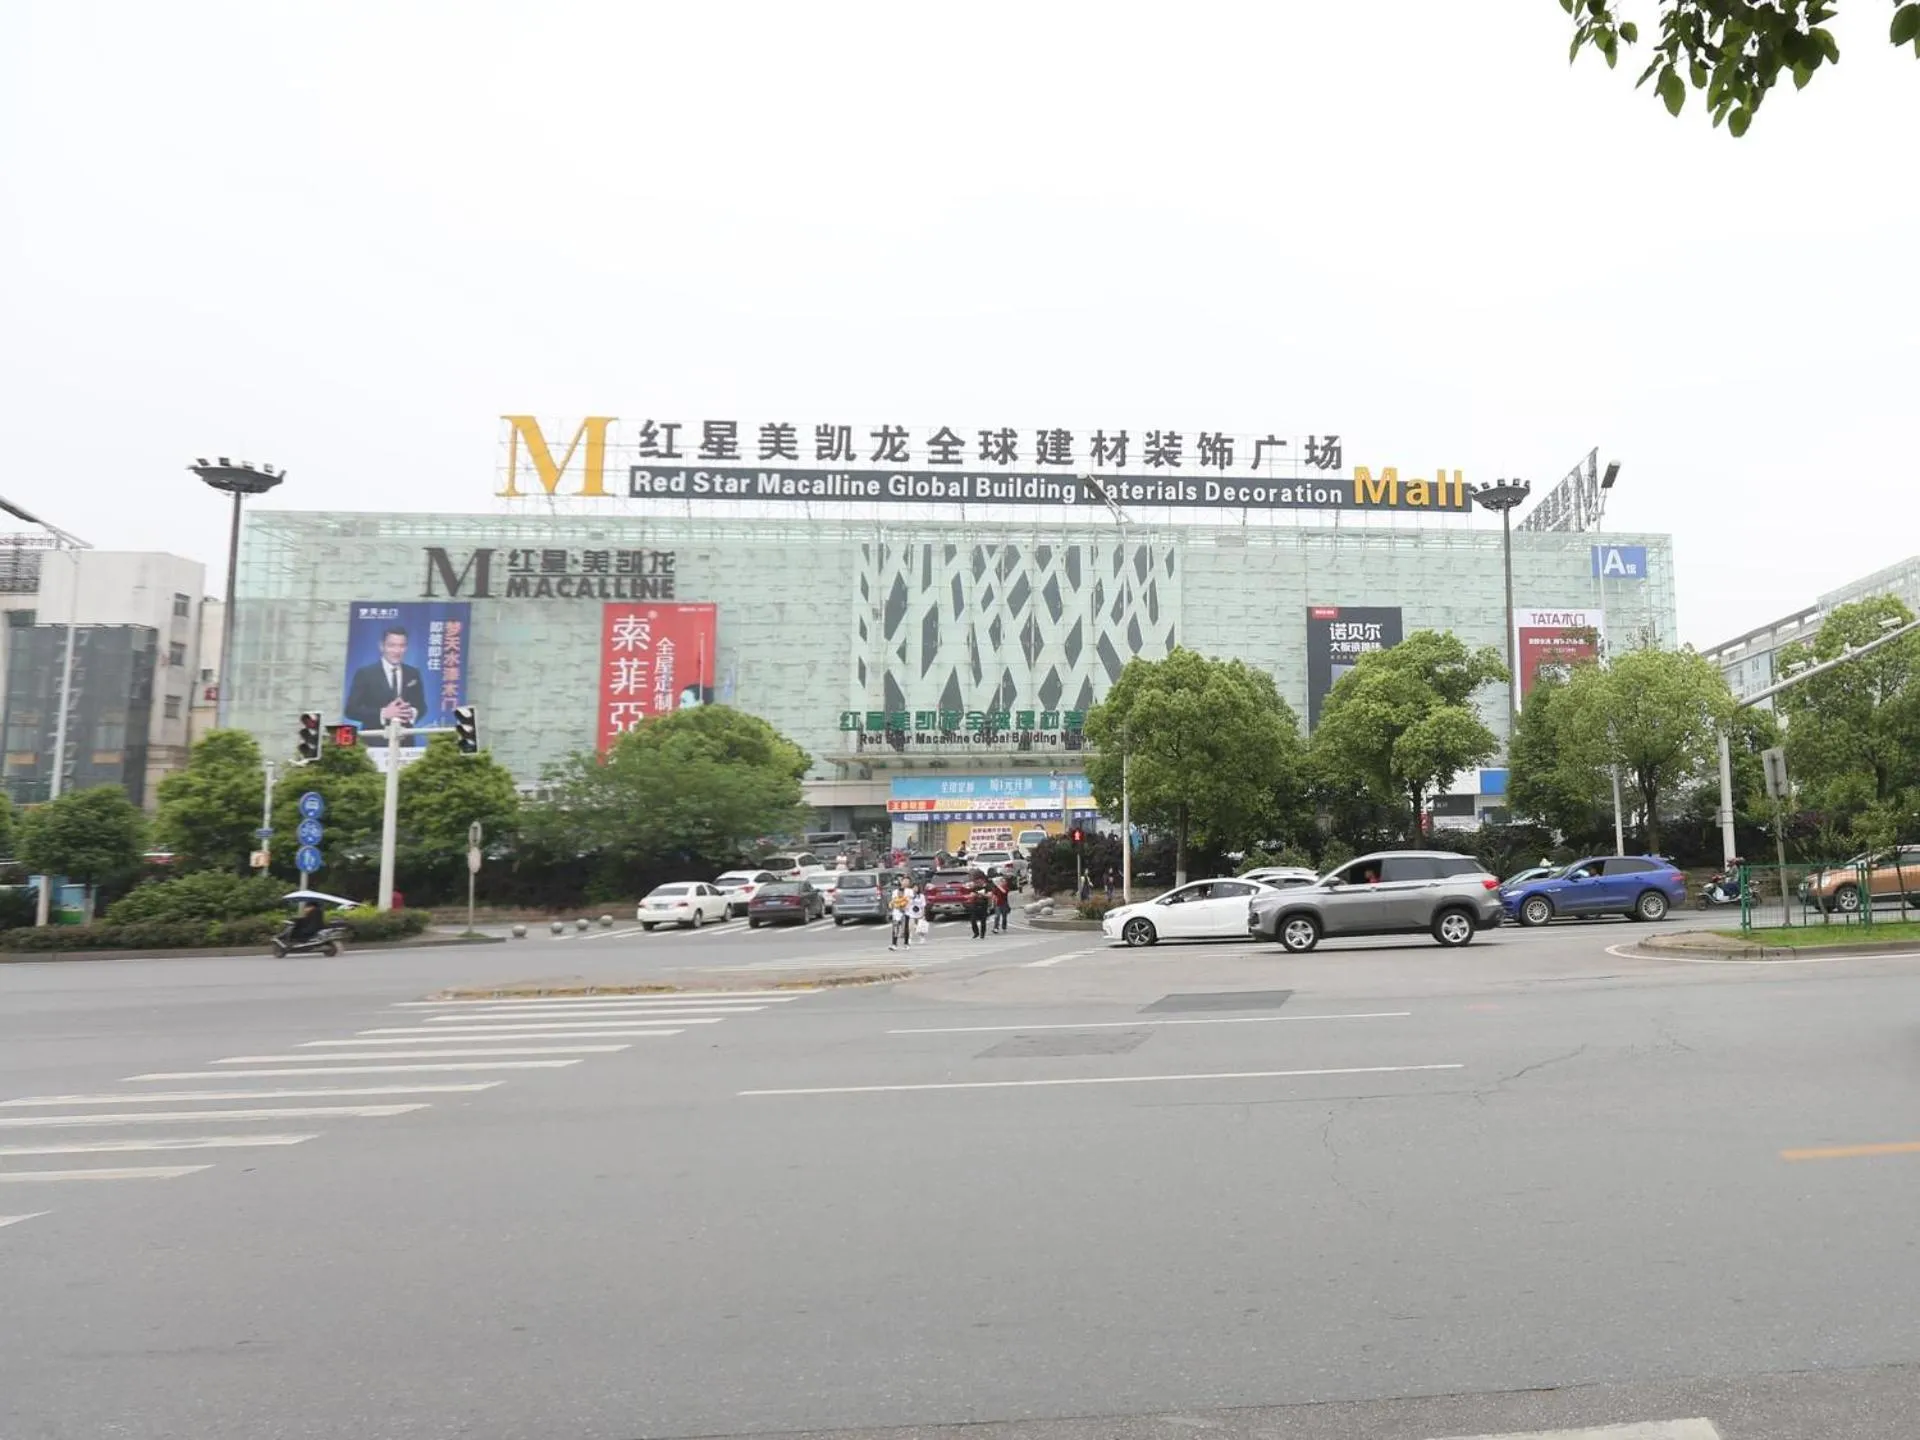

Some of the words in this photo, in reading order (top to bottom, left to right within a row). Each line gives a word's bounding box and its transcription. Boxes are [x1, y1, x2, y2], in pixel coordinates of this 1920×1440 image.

[639, 419, 1342, 471] 红星美凯龙全球建材装饰广场
[634, 471, 685, 493] Red
[693, 471, 750, 495] Star
[758, 472, 881, 497] Macalline
[888, 475, 968, 498] Global
[976, 477, 1076, 504] Building
[1205, 482, 1342, 503] Decoration
[1354, 467, 1464, 507] Mall
[506, 577, 676, 598] MACALLINE
[1329, 623, 1381, 640] 诺贝尔
[653, 637, 676, 711] 全屋定制
[860, 733, 882, 744] Red
